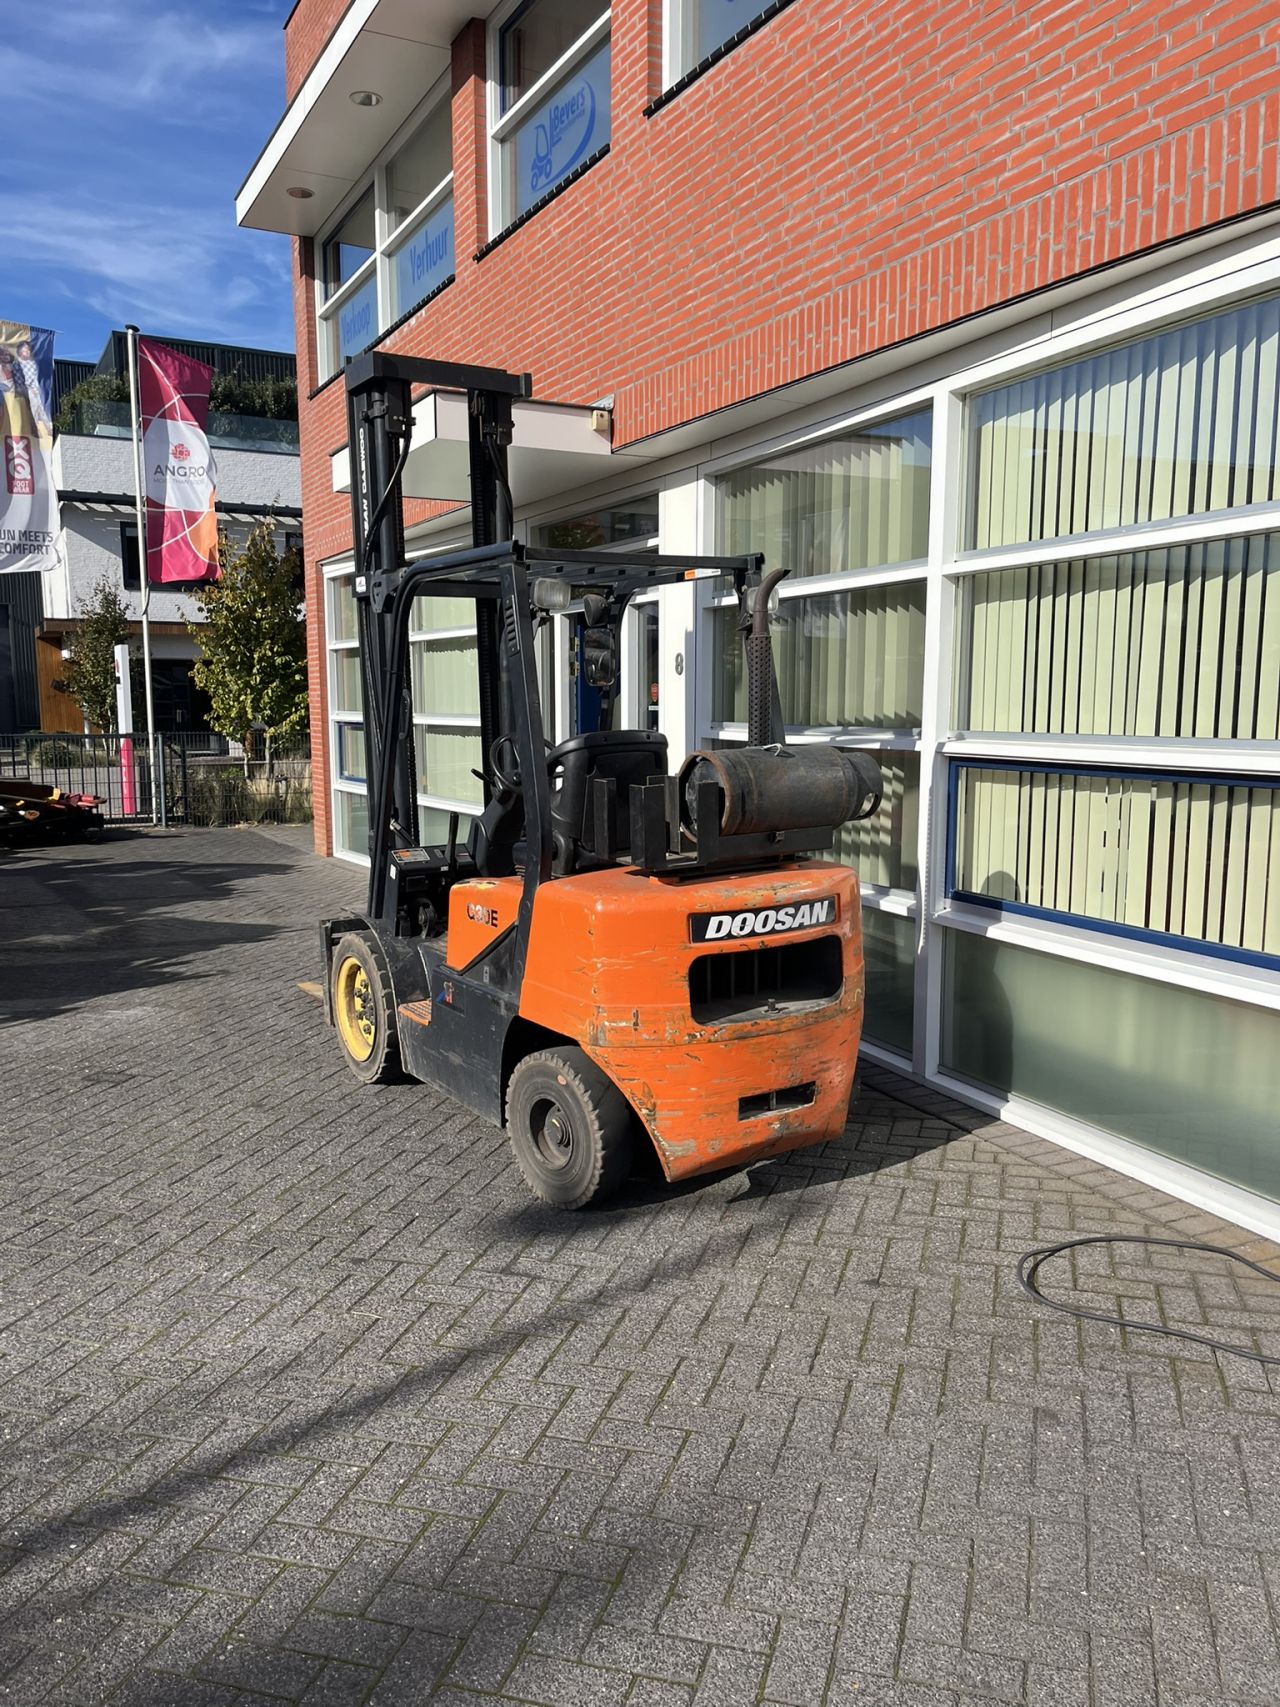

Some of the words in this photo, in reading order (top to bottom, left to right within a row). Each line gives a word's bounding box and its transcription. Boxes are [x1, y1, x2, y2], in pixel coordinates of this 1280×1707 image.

[553, 87, 585, 131] Bevers
[410, 227, 449, 286] Verhuur
[153, 464, 205, 477] ANGRO
[18, 530, 53, 542] MEETS
[675, 652, 684, 675] 8
[704, 900, 829, 940] DOOSAN
